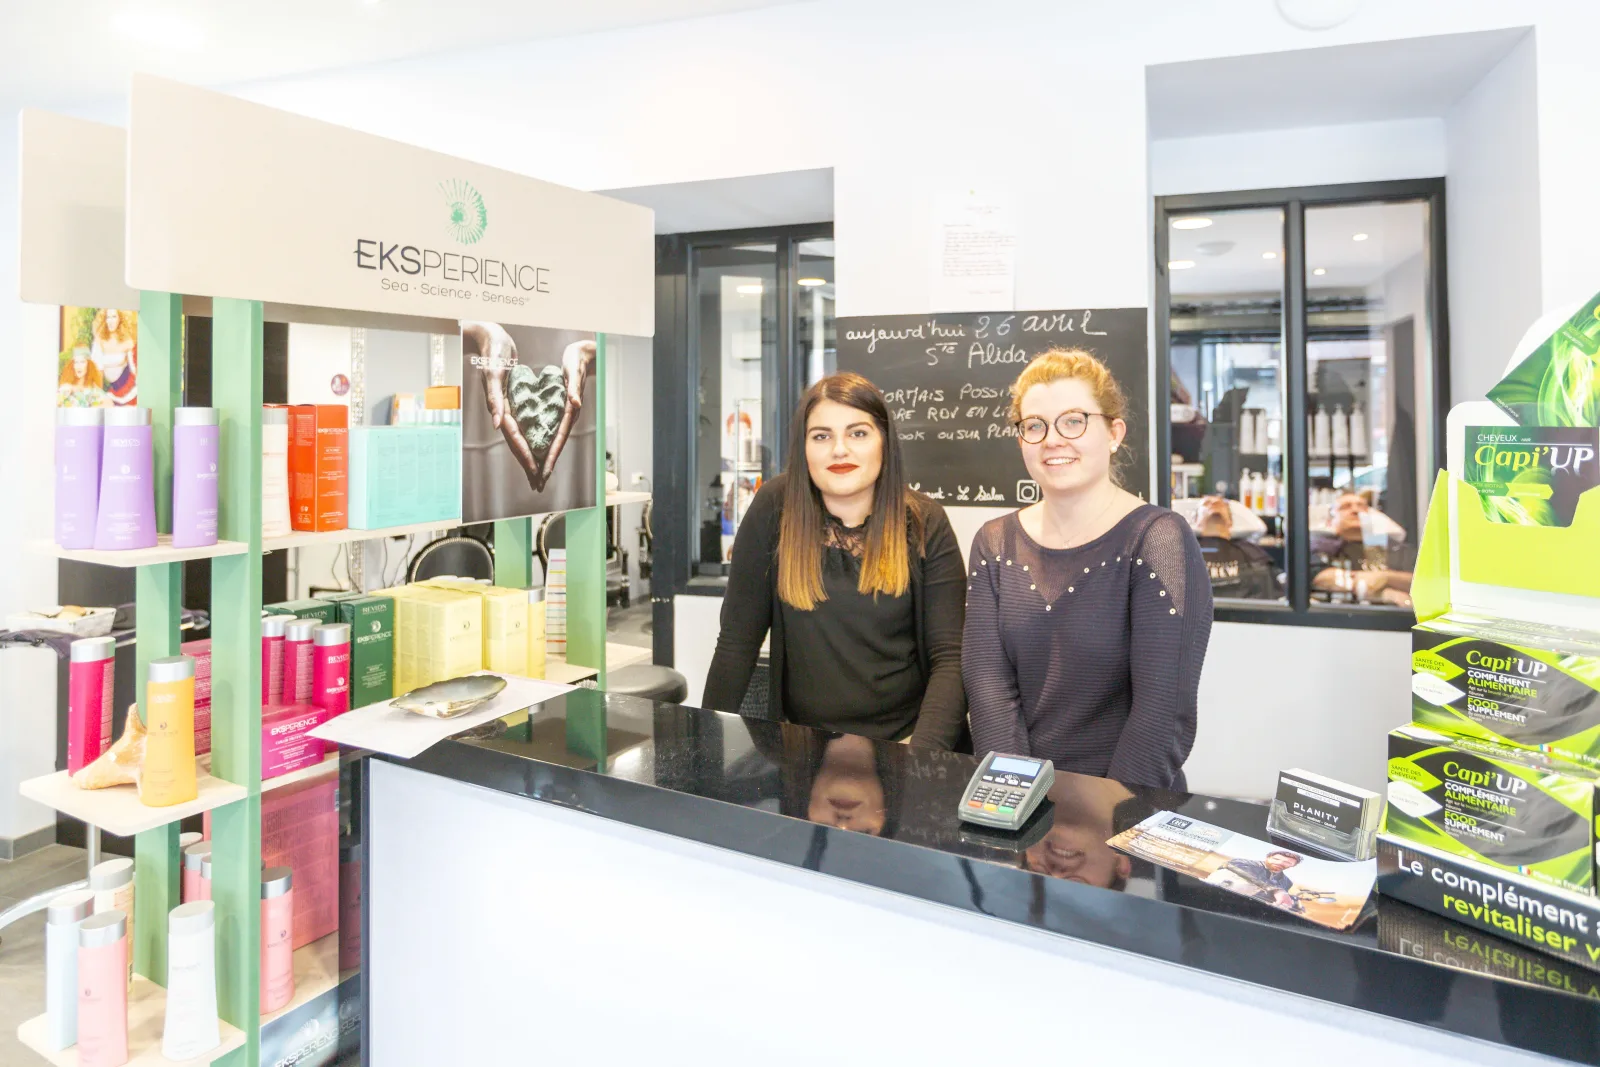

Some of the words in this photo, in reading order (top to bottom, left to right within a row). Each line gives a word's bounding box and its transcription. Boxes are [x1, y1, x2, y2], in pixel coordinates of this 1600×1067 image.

[353, 238, 550, 294] EKSPERIENCE
[381, 278, 409, 292] Sea
[420, 283, 472, 300] Science
[846, 319, 966, 354] aujourd'hui
[974, 315, 1015, 339] 26
[1022, 310, 1107, 335] avril
[968, 342, 1028, 369] Alida
[881, 387, 944, 407] ORMAIS
[927, 406, 959, 421] RDV
[966, 406, 988, 418] EN
[1477, 434, 1518, 442] CHEVEUX
[1474, 445, 1595, 471] Capi'UP
[974, 485, 1005, 501] Salon
[362, 603, 387, 613] REVLON
[1466, 650, 1548, 677] Capi'UP
[1467, 669, 1531, 688] COMPLÉMENT
[1467, 677, 1538, 698] ALIMENTAIRE
[1467, 697, 1499, 710] FOOD
[1467, 704, 1527, 723] SUPPLEMENT
[271, 716, 318, 736] EKSPERIENCE
[1443, 761, 1528, 794] Capi'UP
[1444, 782, 1510, 805] COMPLÉMENT
[1444, 790, 1517, 816] ALIMENTAIRE
[1293, 802, 1339, 823] PLANITY
[1444, 811, 1477, 826] FOOD
[1444, 818, 1505, 842] SUPPLEMENT
[1398, 850, 1424, 876] Le
[1431, 867, 1589, 934] complément
[1443, 894, 1577, 953] revitaliser
